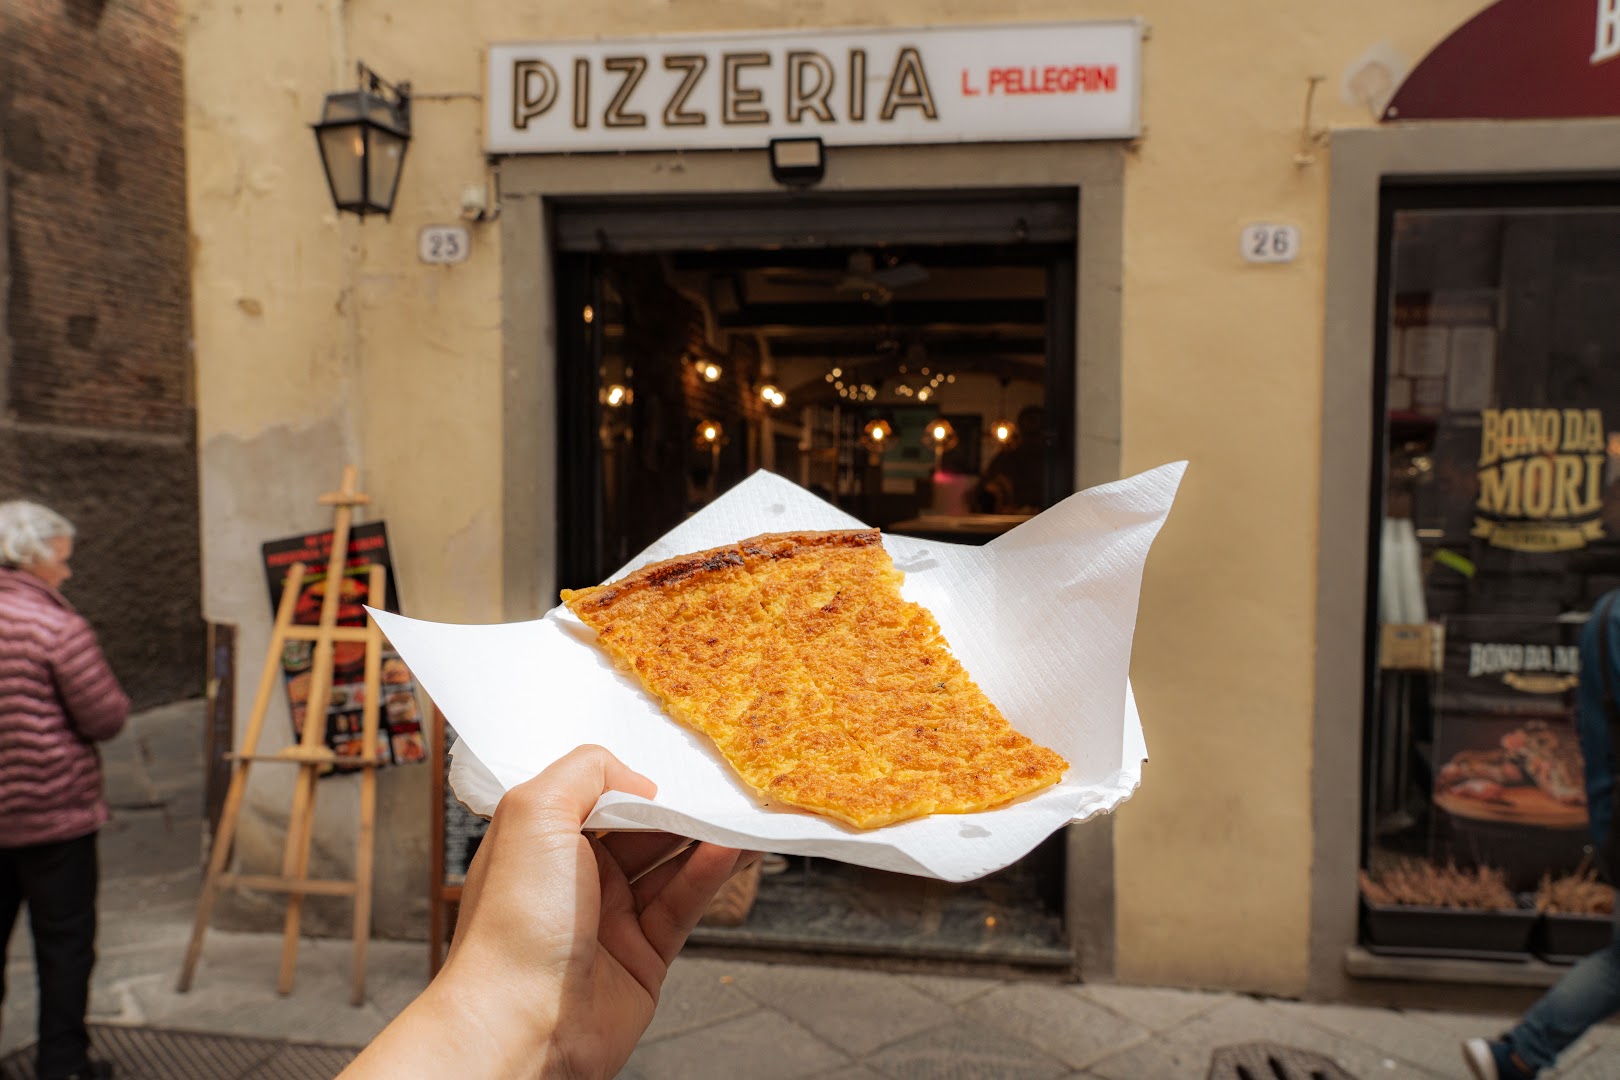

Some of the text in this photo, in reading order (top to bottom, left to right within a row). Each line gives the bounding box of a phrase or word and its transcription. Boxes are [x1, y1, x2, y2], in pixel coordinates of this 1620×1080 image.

[512, 47, 939, 130] PIZZERIA
[987, 64, 1119, 97] PELLEGRINI
[429, 231, 460, 257] 25
[1252, 227, 1290, 256] 26
[1480, 408, 1605, 467] BONO DA
[1477, 454, 1604, 517] MORI
[1468, 642, 1524, 678] BONO
[1525, 645, 1552, 671] DA
